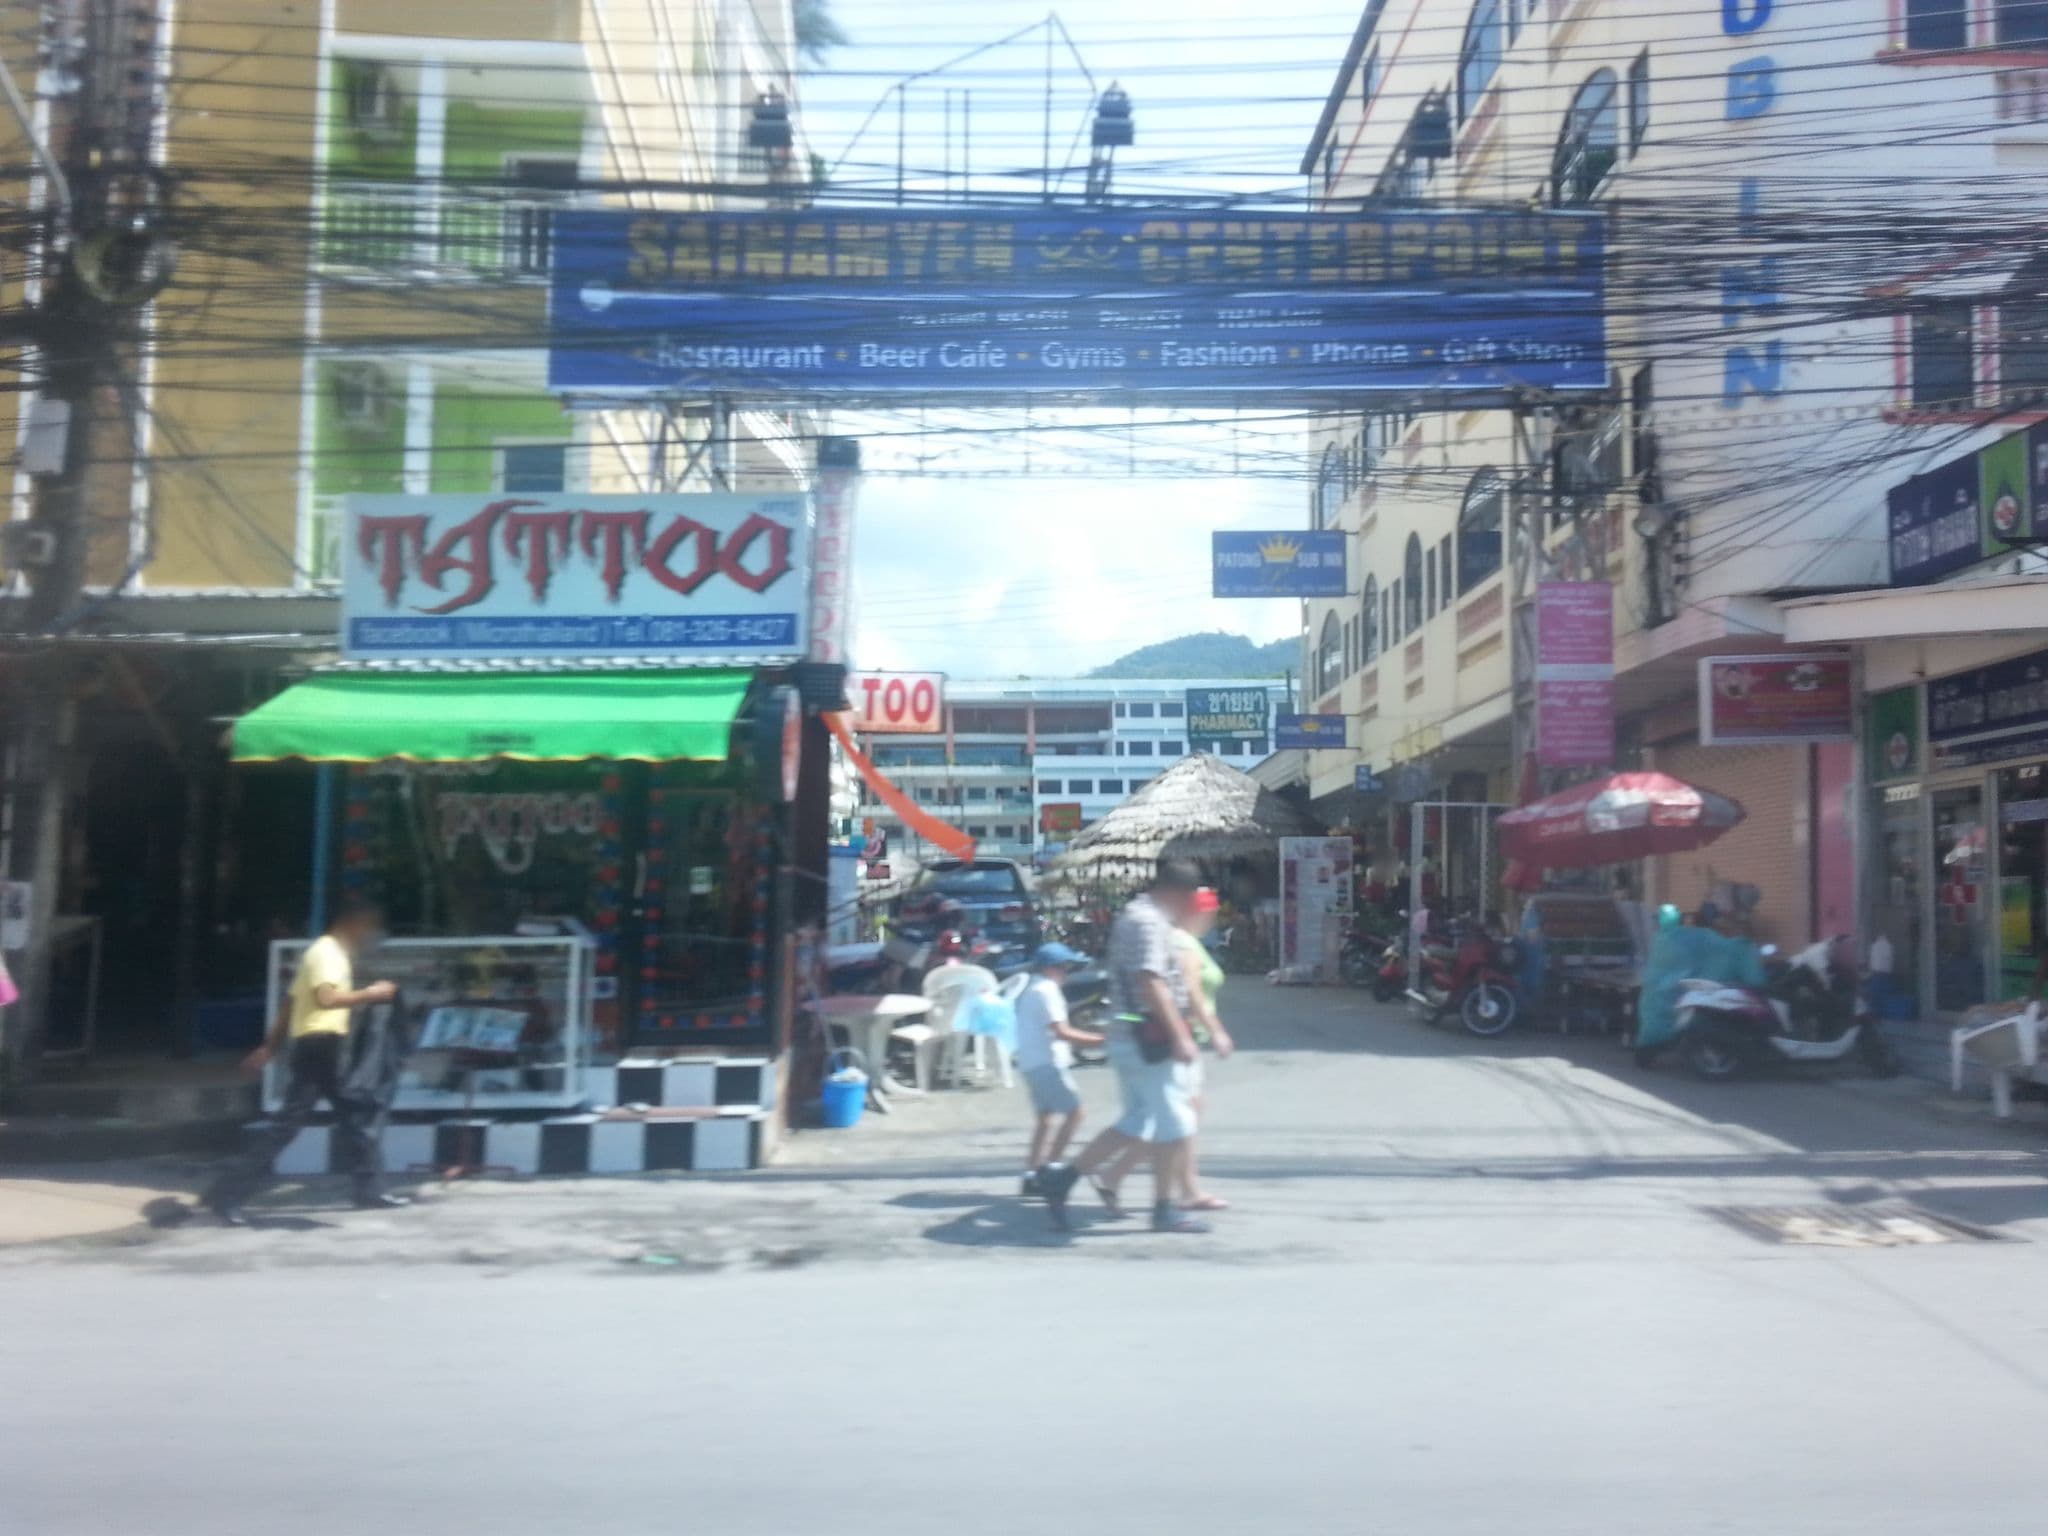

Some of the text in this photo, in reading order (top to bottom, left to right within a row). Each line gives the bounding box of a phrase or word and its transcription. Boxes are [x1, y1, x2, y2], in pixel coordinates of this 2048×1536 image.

[655, 340, 824, 369] Restaurant
[860, 343, 929, 368] Beer
[1040, 342, 1127, 370] Gyms
[1161, 340, 1278, 367] Fashion
[1312, 342, 1408, 365] Phone
[358, 499, 794, 615] TATTOO
[862, 677, 936, 723] TOO
[1189, 713, 1263, 731] PHARMACY
